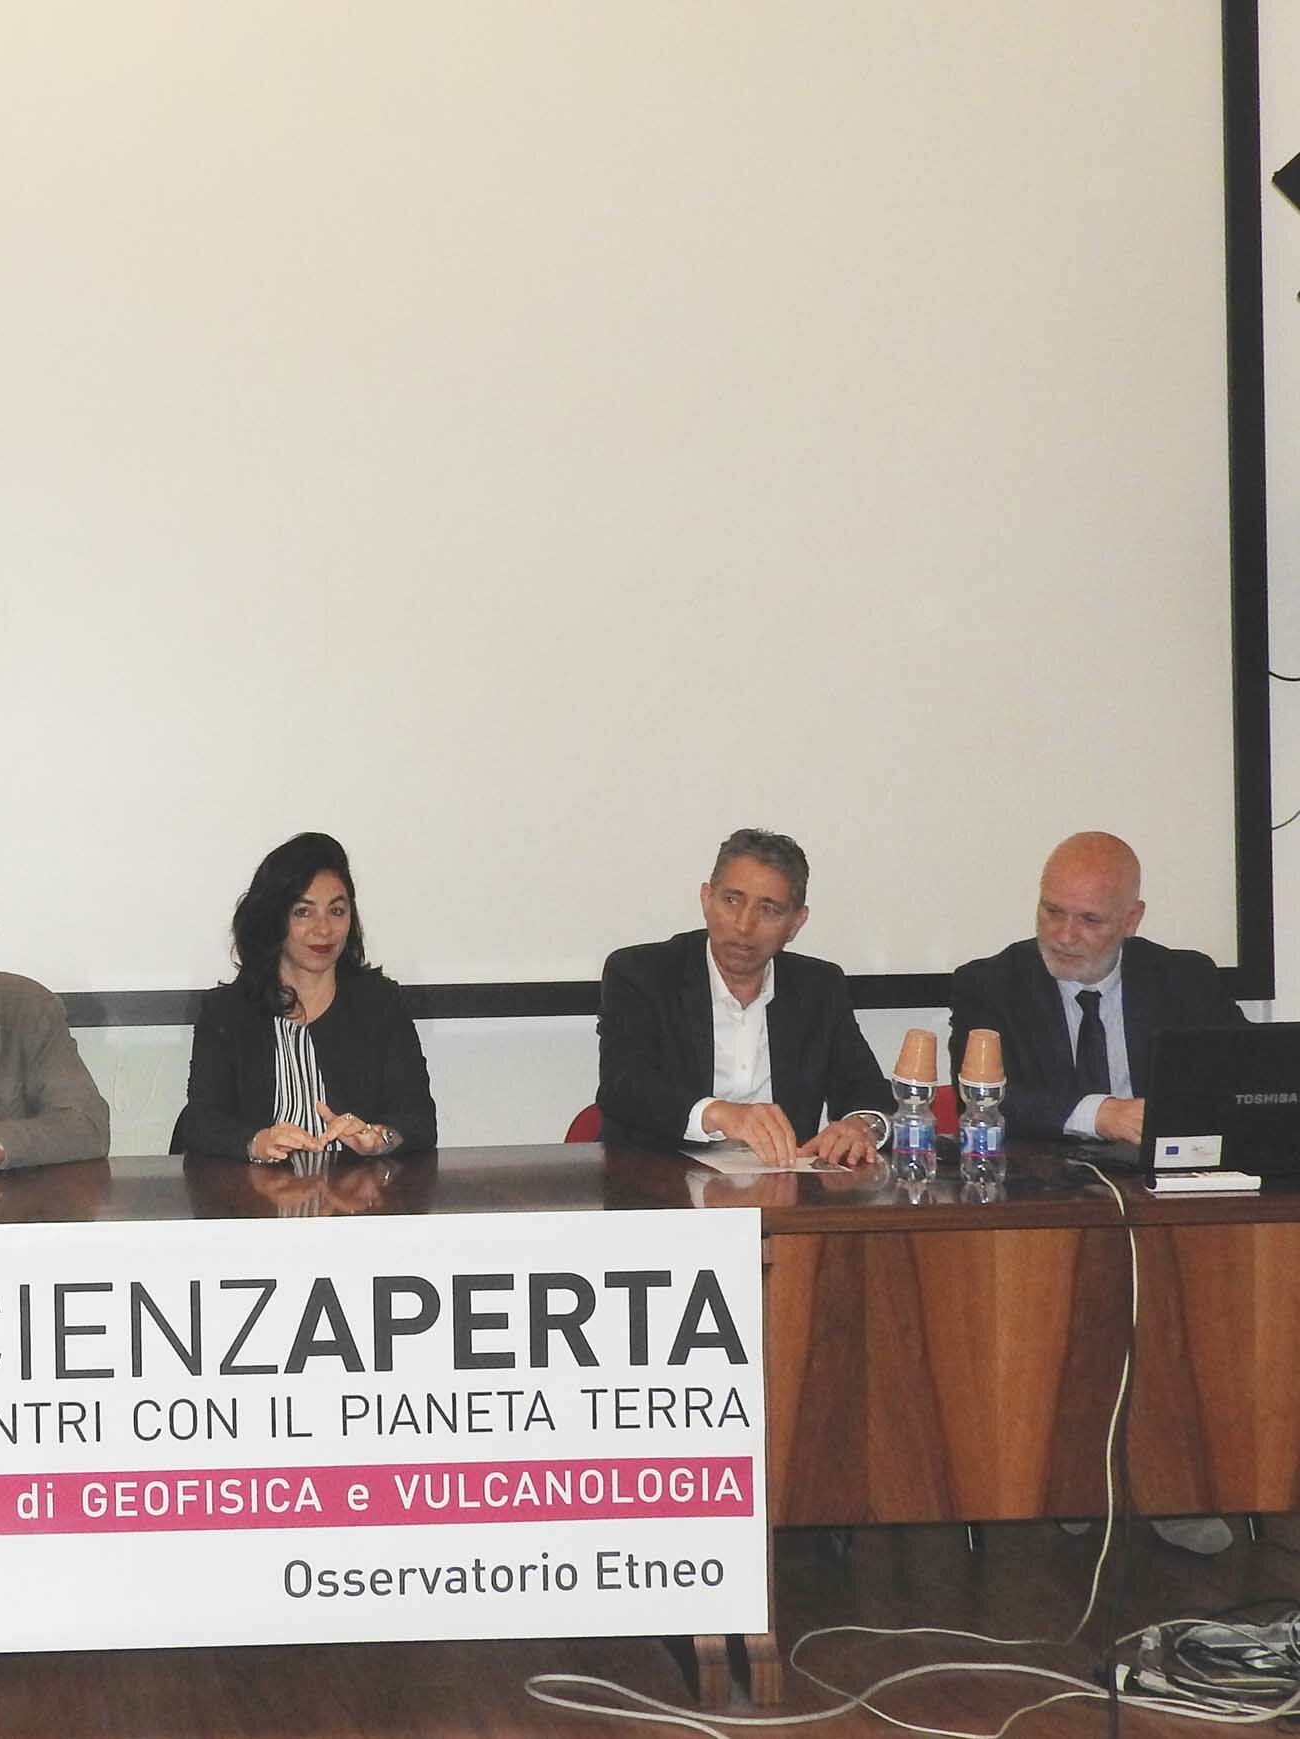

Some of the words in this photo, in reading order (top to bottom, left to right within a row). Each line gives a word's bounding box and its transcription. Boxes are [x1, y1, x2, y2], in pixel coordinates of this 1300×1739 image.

[1235, 1092, 1298, 1105] TOSHIBA
[133, 1397, 238, 1442] CON
[270, 1396, 313, 1438] IL
[341, 1389, 556, 1437] PIANETA
[580, 1386, 750, 1430] TERRA
[17, 1482, 54, 1520] di
[82, 1477, 323, 1518] GEOFISICA
[347, 1483, 370, 1512] e
[394, 1467, 743, 1510] VULCANOLOGIA
[284, 1552, 578, 1599] Osservatorio
[596, 1551, 724, 1590] Etneo
